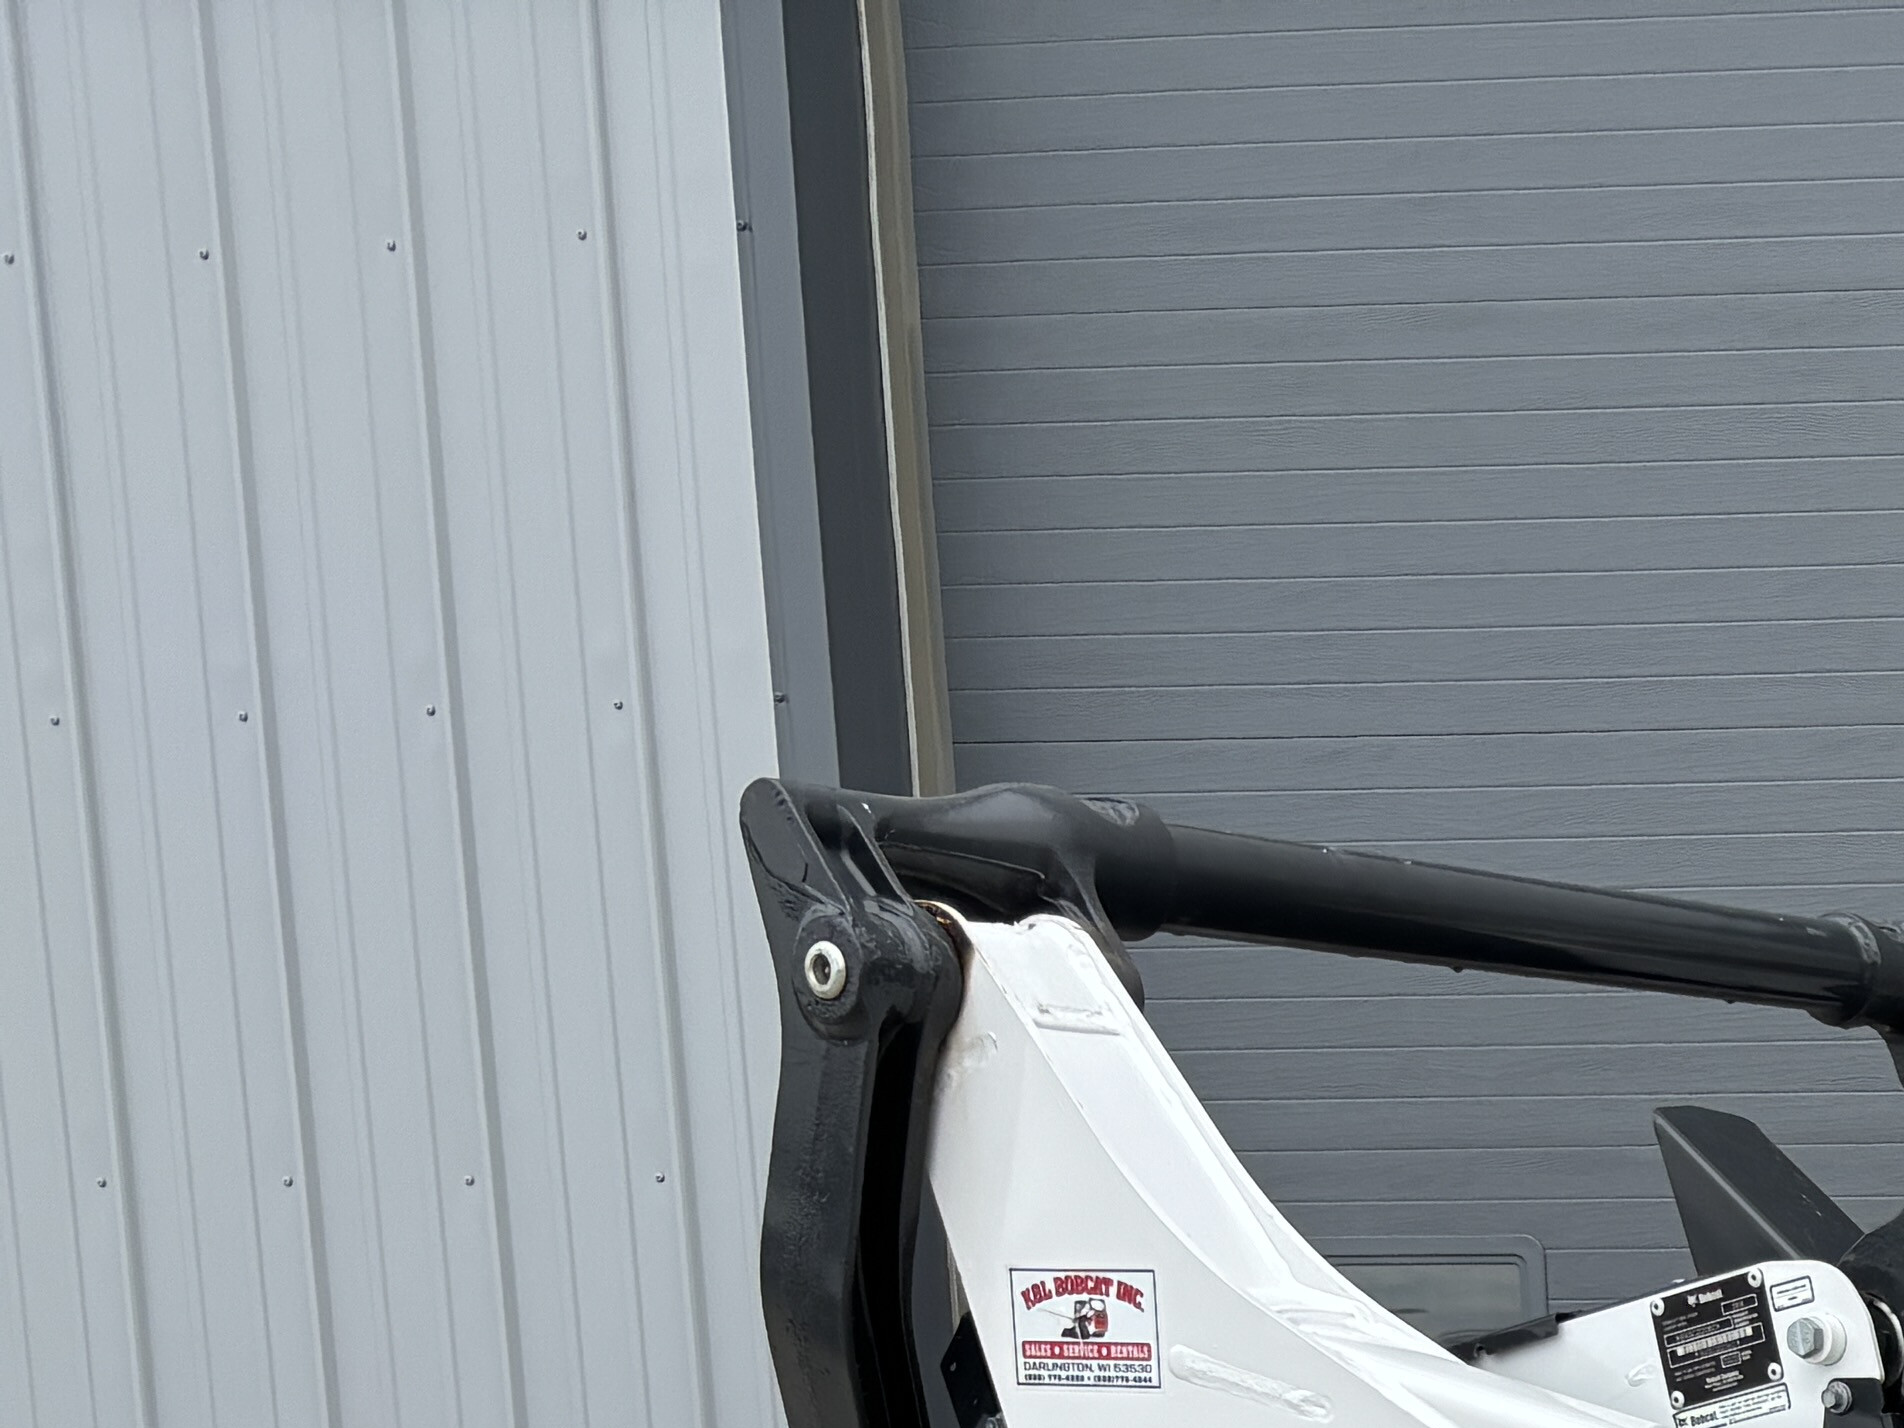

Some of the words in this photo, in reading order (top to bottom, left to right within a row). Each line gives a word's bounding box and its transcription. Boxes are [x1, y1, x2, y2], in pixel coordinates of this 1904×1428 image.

[1053, 1275, 1114, 1298] BOBCAT
[1116, 1280, 1145, 1312] INC.
[1024, 1343, 1051, 1356] SALES
[1062, 1344, 1099, 1357] SERVICE
[1110, 1345, 1148, 1358] RENTALS
[1023, 1361, 1094, 1373] DARLINGTON,
[1097, 1362, 1111, 1372] WI
[1113, 1364, 1152, 1374] 53530
[1690, 1411, 1719, 1427] Bobcat
